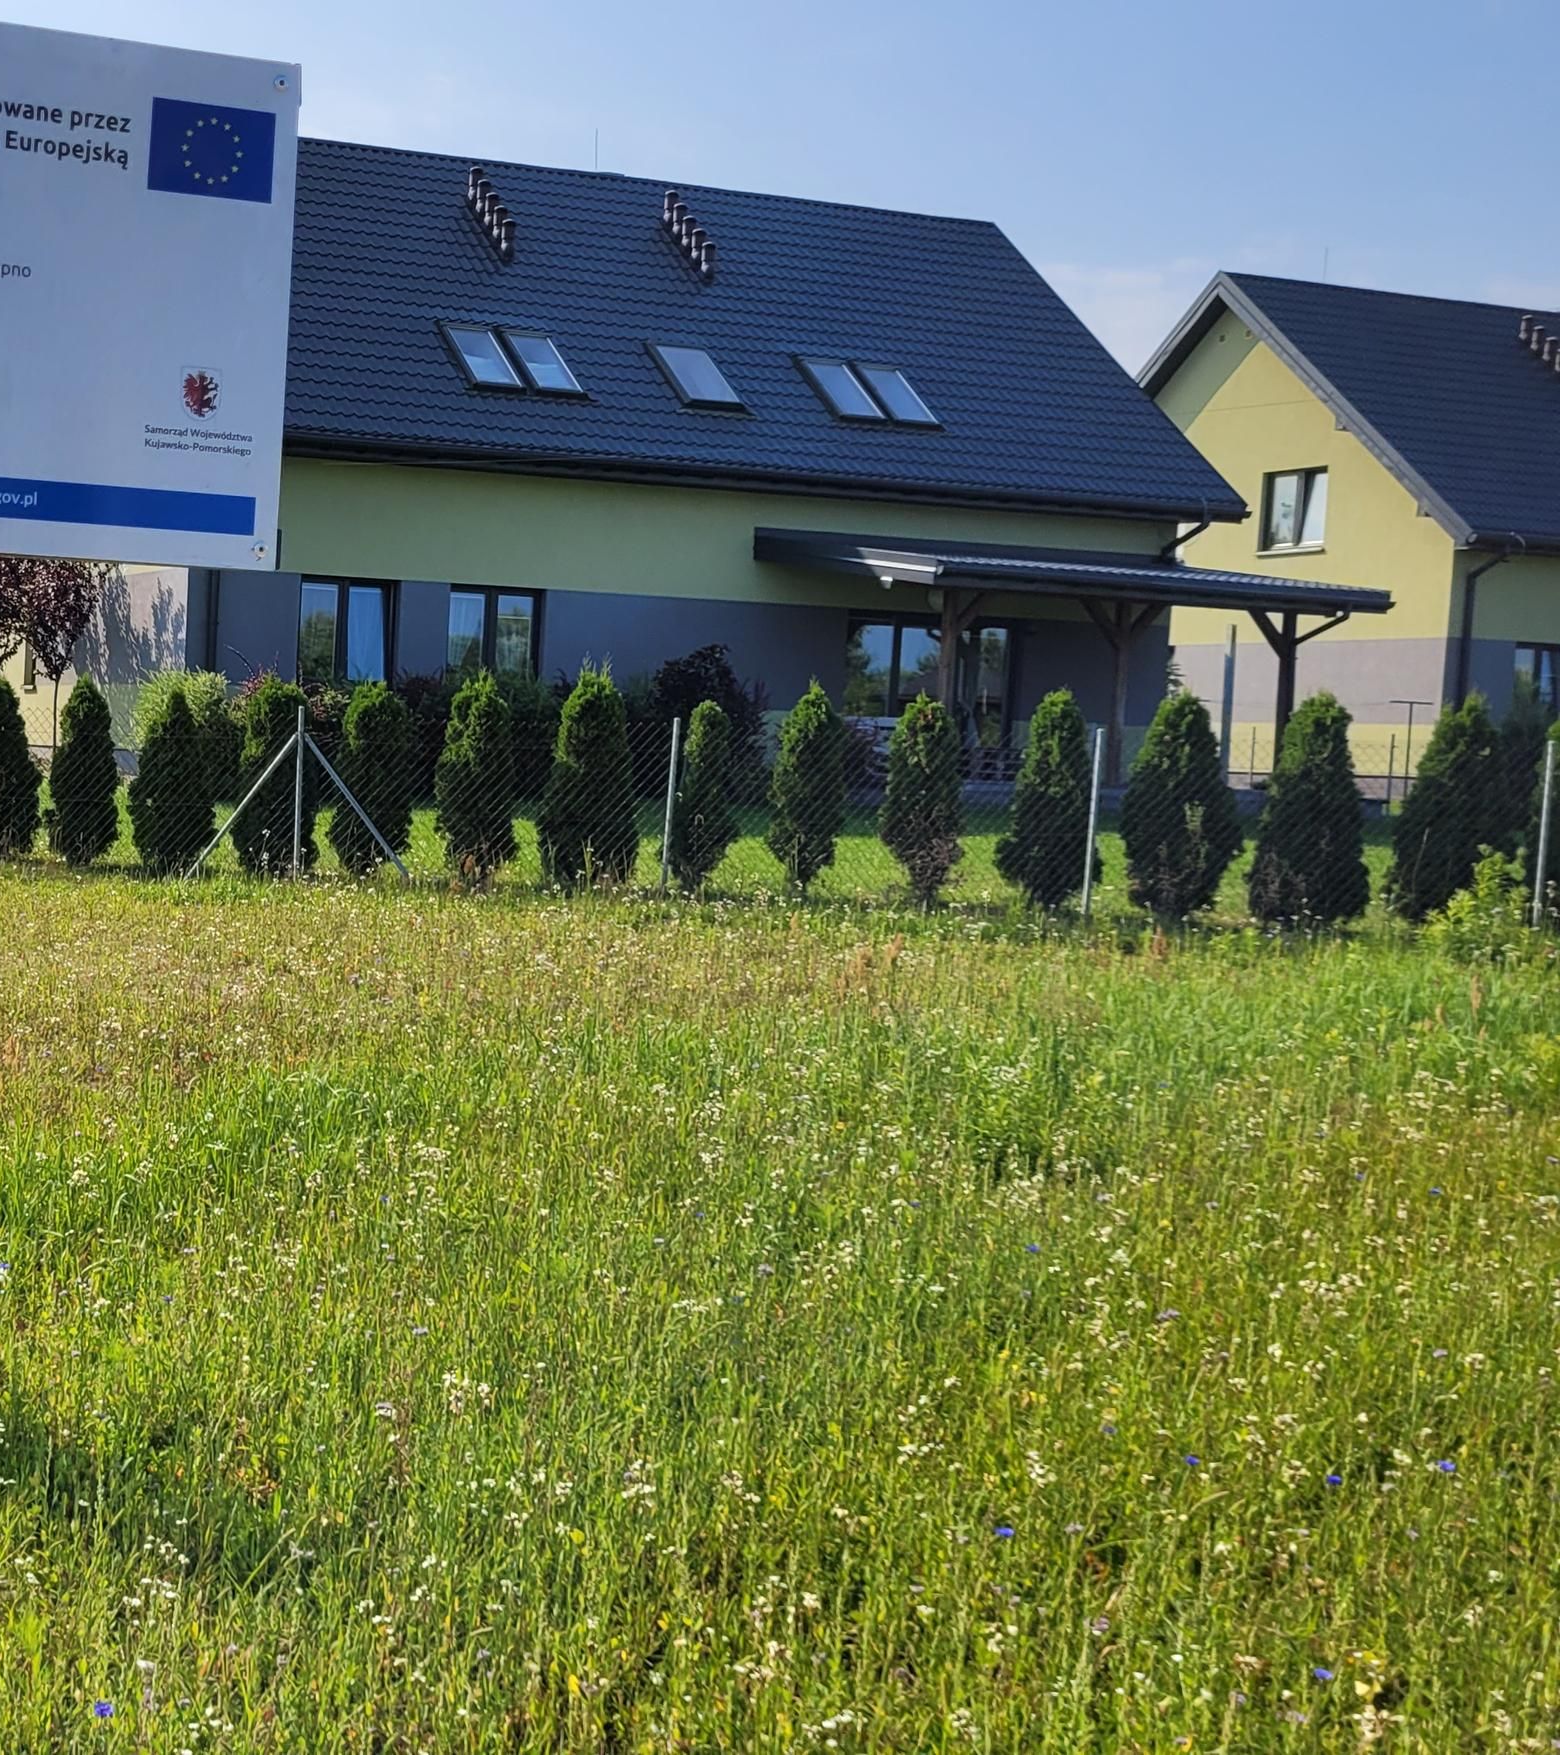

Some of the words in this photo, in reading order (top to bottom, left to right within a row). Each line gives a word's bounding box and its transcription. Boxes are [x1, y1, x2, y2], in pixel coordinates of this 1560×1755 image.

[70, 111, 131, 133] przez
[5, 130, 128, 170] Europejską
[145, 424, 189, 438] Samorząd
[190, 429, 253, 442] Województwa
[145, 438, 252, 457] Kujawsko-Pomorskiego
